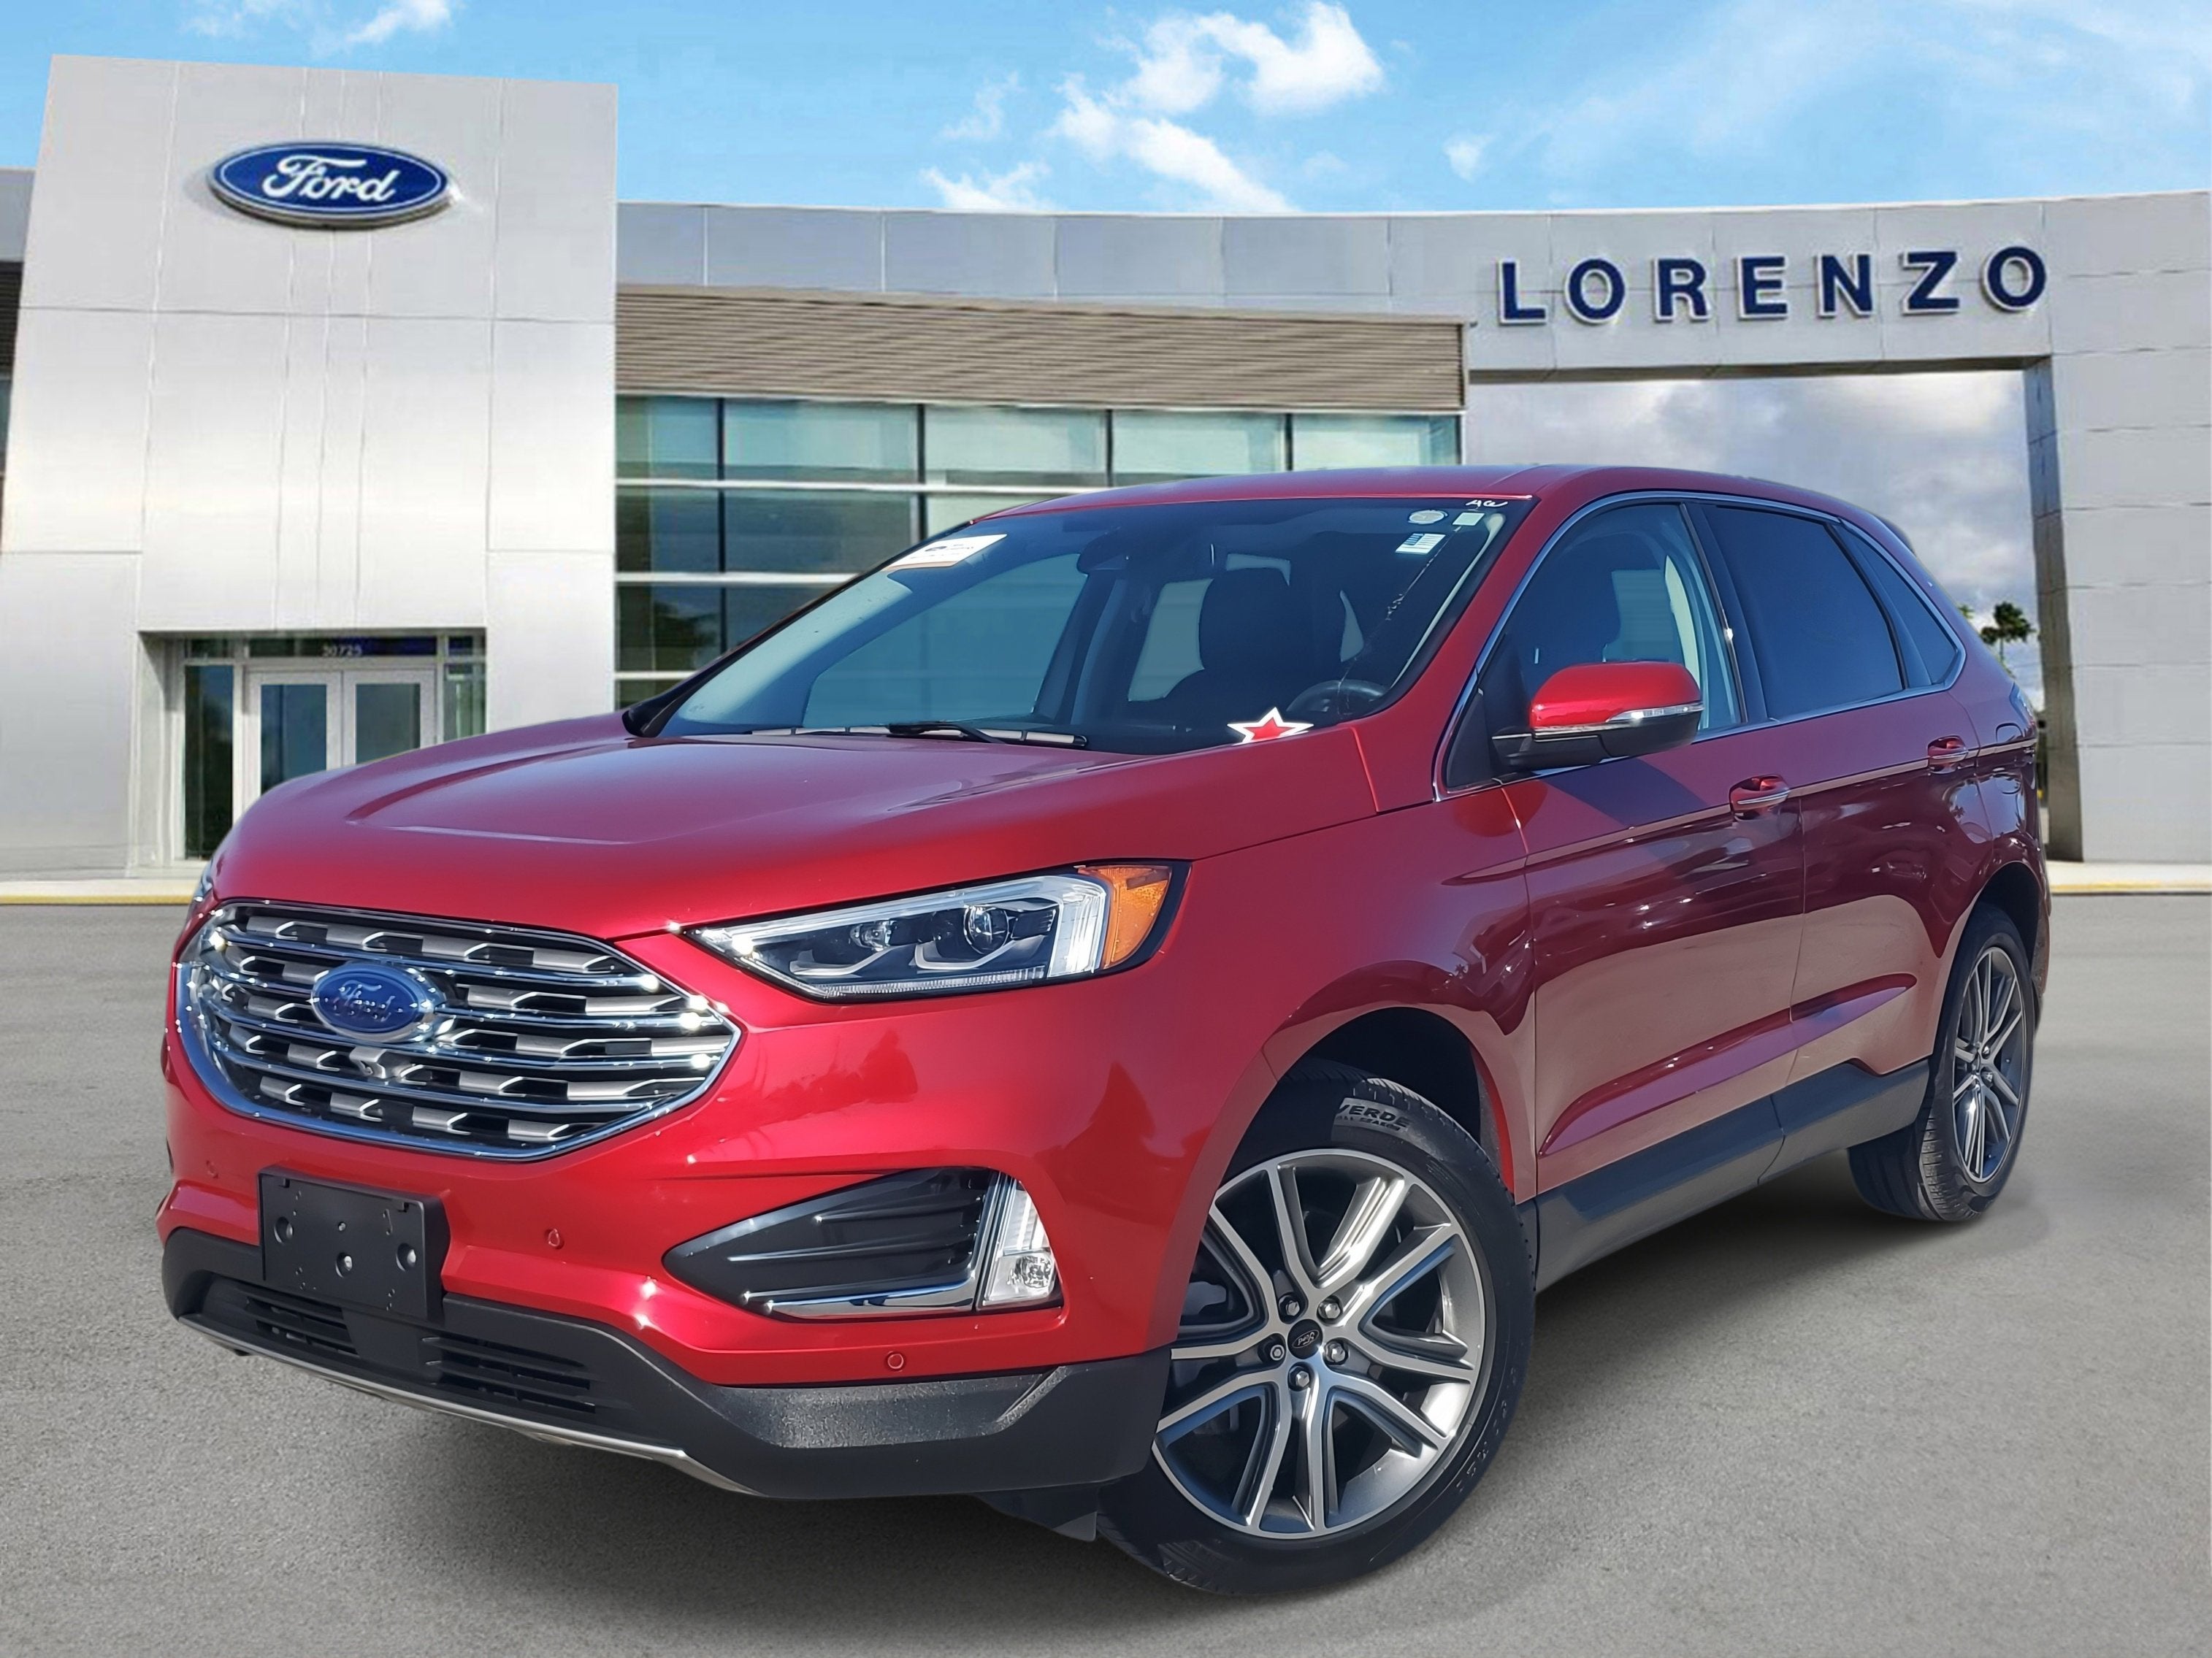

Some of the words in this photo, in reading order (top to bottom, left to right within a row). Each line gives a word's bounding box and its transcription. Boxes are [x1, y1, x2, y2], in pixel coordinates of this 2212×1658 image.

[261, 155, 400, 202] Ford
[1499, 246, 2047, 323] LORENZO
[333, 980, 396, 1024] Ford
